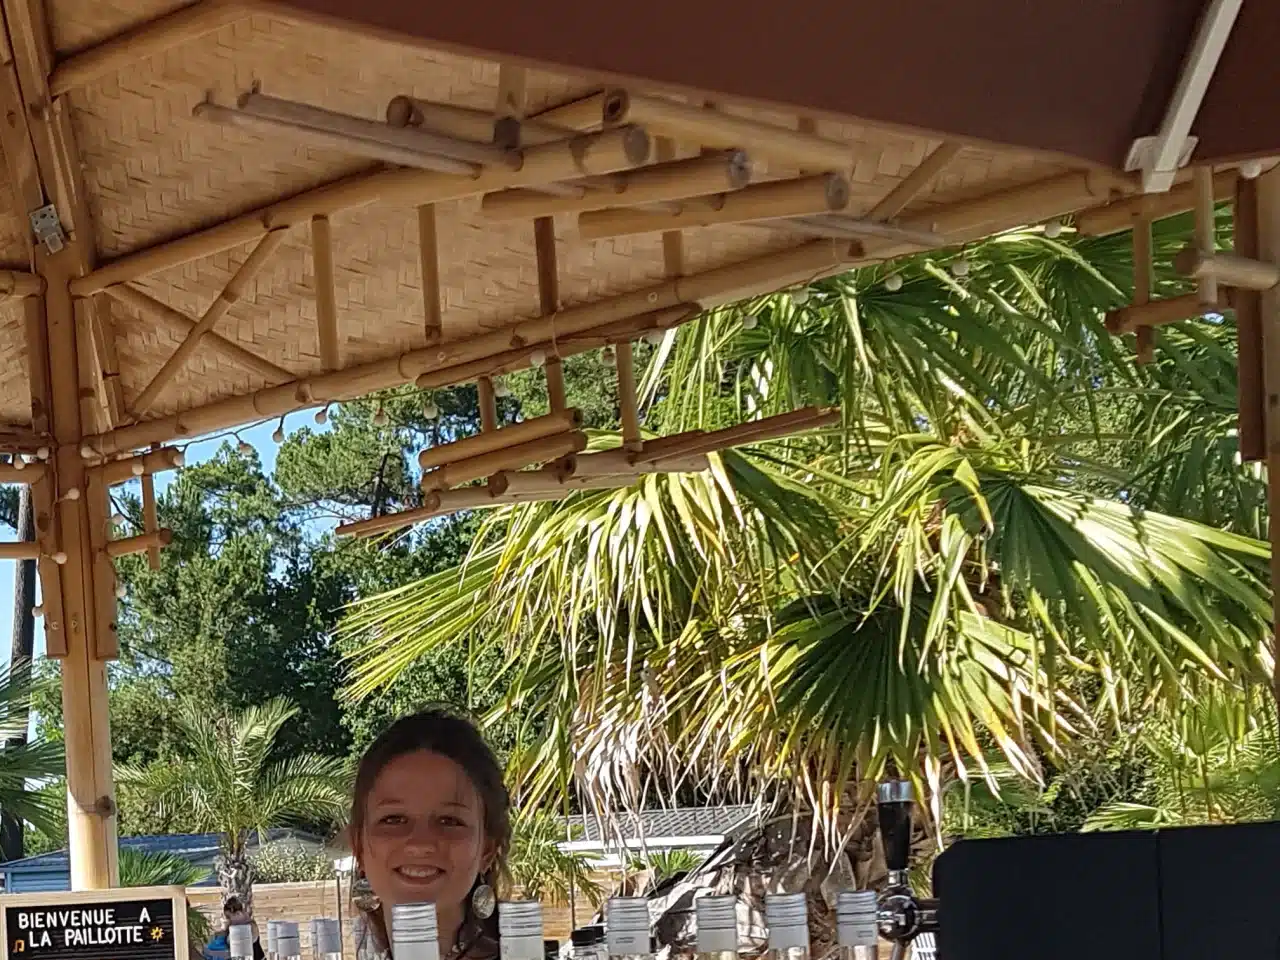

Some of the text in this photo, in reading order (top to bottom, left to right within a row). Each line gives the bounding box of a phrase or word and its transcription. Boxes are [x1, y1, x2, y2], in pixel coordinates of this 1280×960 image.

[19, 907, 150, 929] BIENVENUE A
[29, 925, 143, 947] LA PAILLOTTE
